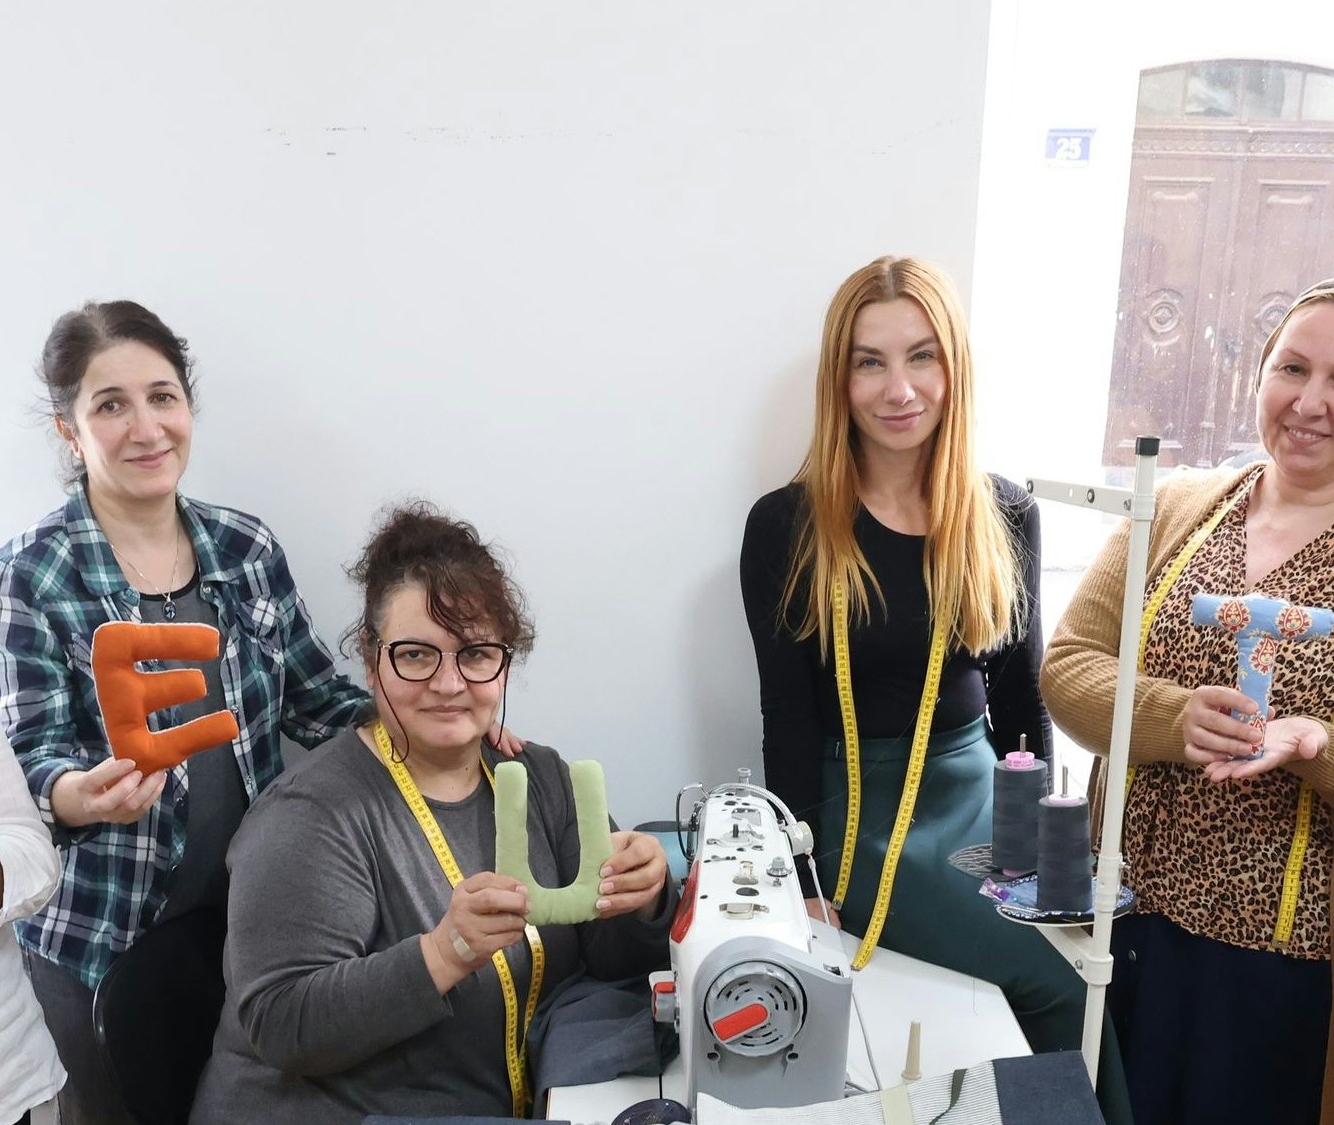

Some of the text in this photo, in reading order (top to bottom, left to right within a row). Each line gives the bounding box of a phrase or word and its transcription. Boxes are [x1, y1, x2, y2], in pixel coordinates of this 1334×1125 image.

[1056, 137, 1083, 160] 25
[91, 621, 239, 775] E
[494, 759, 613, 926] U
